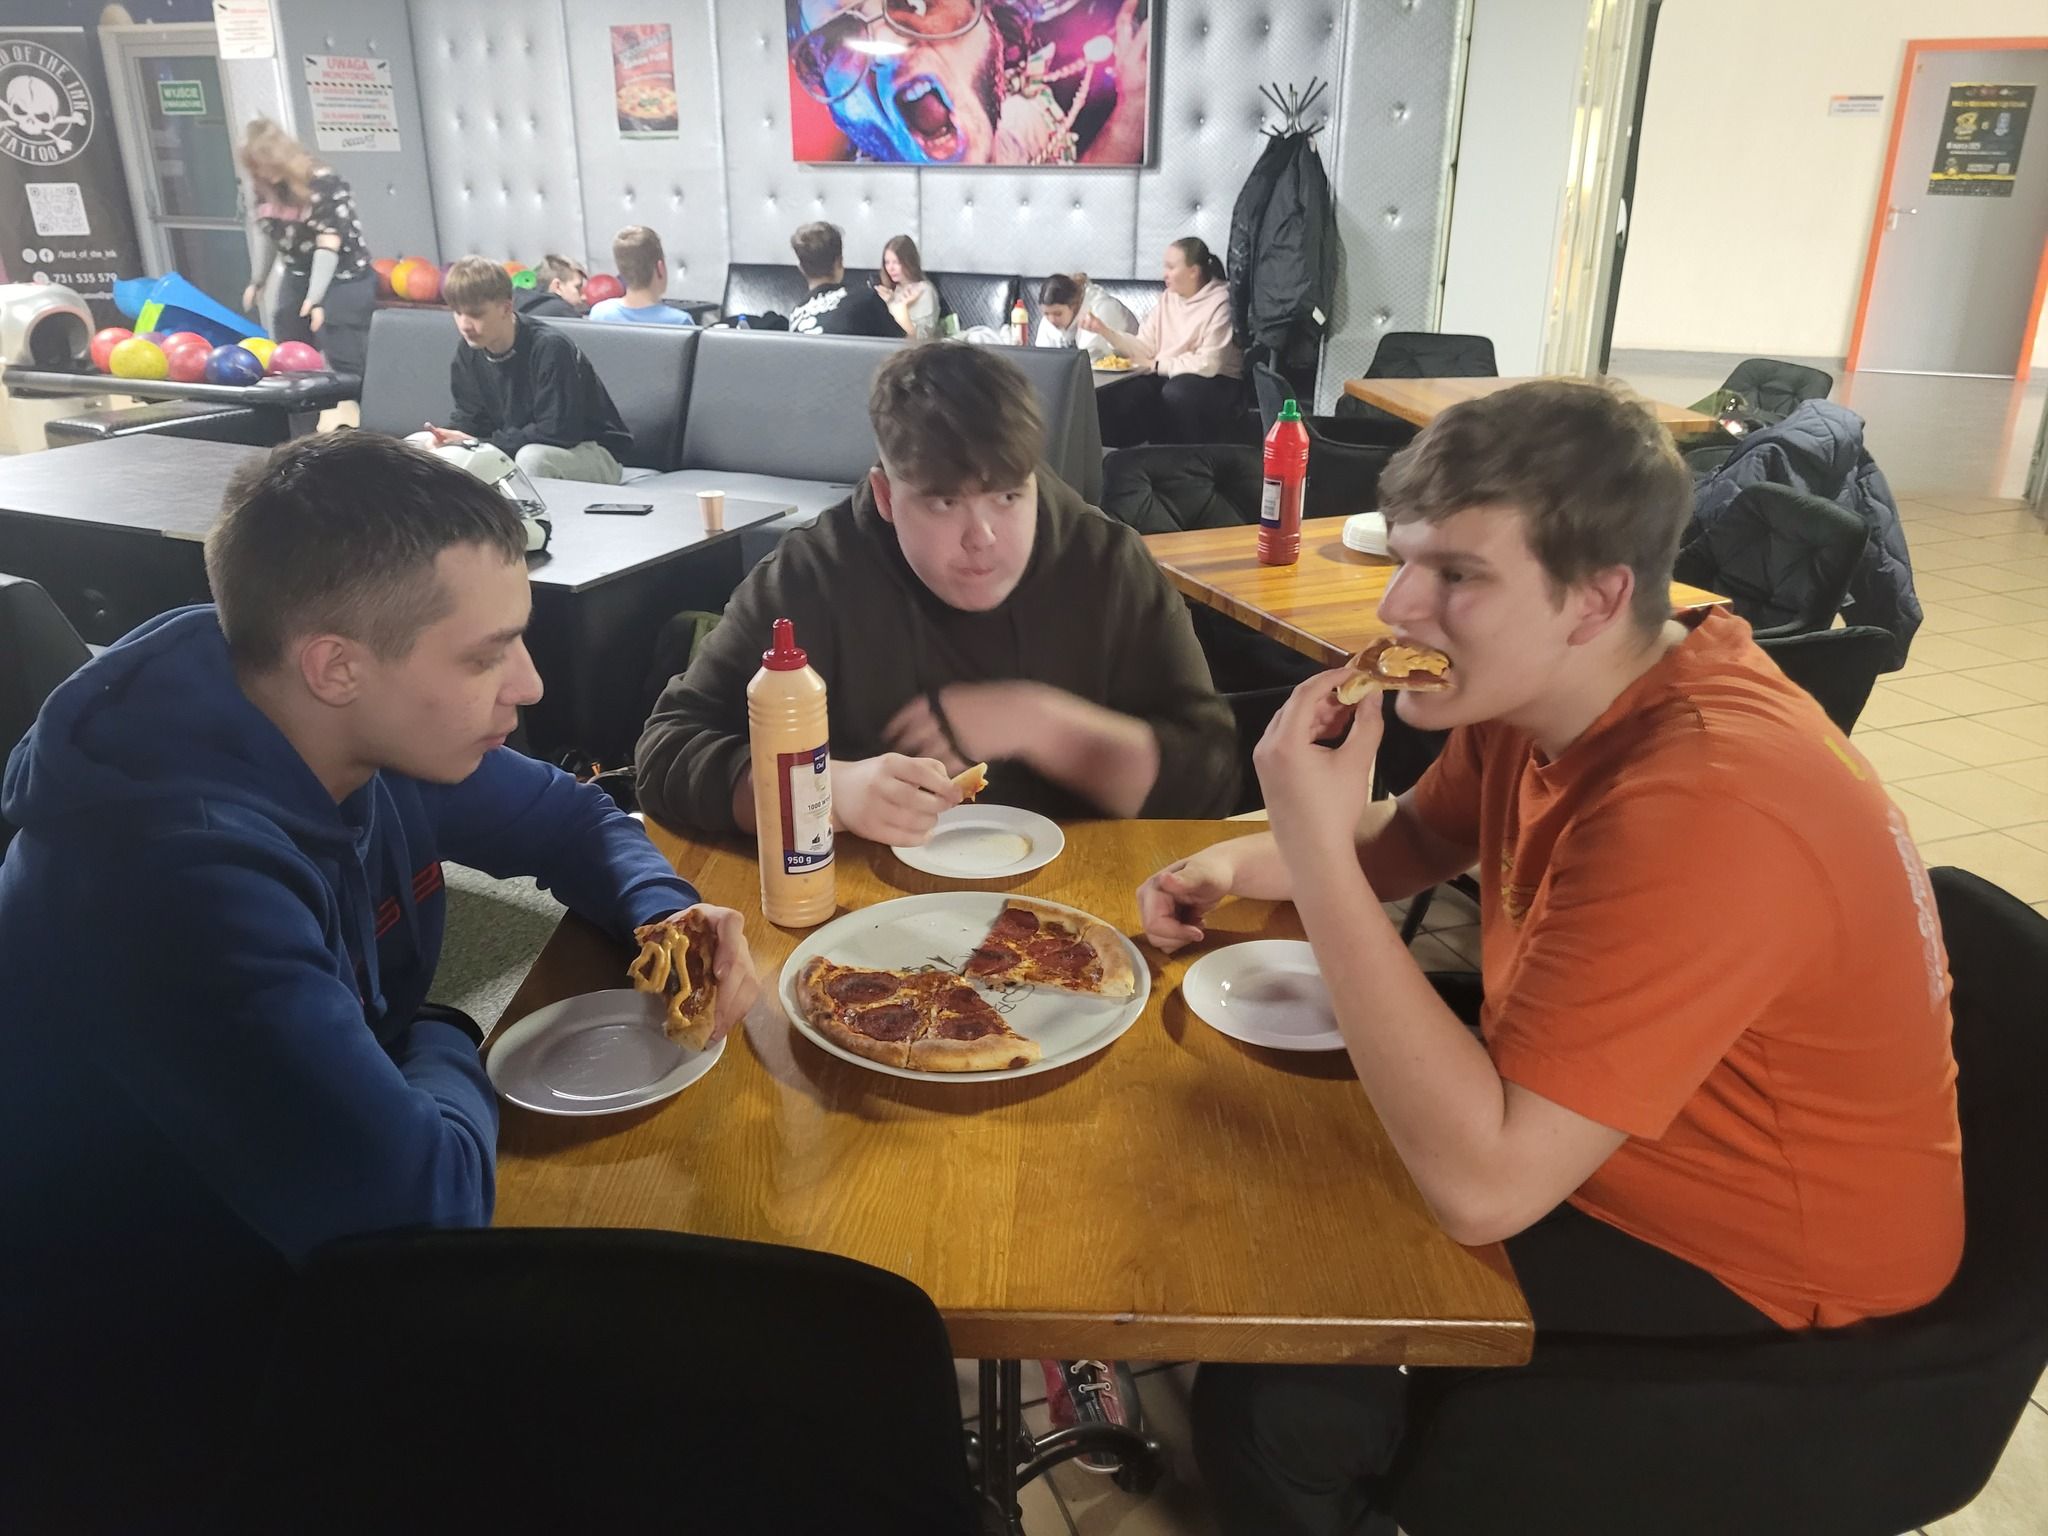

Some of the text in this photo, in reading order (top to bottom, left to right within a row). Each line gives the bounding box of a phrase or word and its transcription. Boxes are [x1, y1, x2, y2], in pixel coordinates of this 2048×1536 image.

[326, 57, 369, 71] UWAGA
[12, 46, 32, 62] OF
[38, 50, 70, 80] THE
[66, 81, 89, 111] INK
[0, 131, 58, 161] TATTOO
[52, 272, 118, 283] 731 535 579
[787, 856, 812, 865] 950 g
